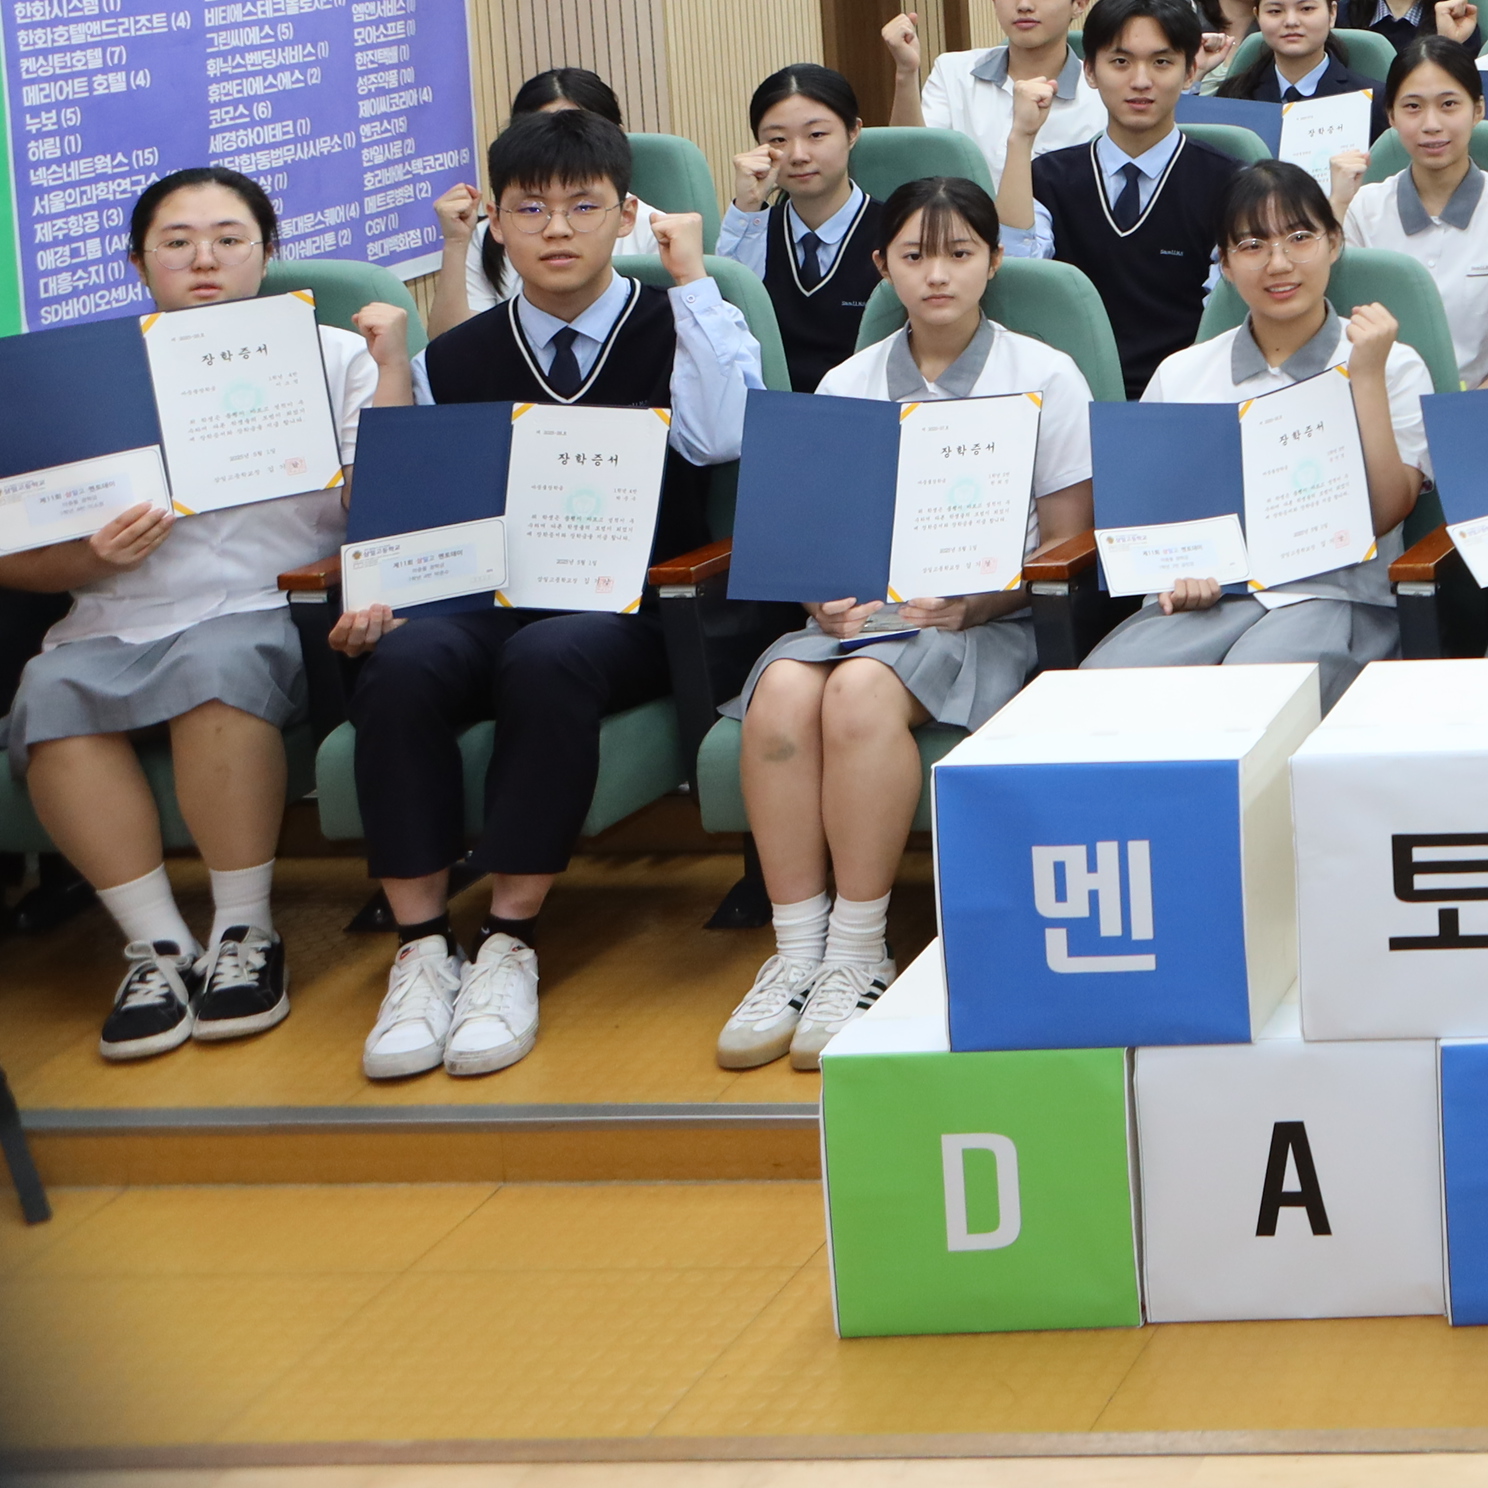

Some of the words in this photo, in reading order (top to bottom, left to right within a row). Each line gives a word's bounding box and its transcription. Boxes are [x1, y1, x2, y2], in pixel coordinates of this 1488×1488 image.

[17, 13, 168, 51] 한화호텔앤드리조트
[171, 11, 191, 31] (4)
[206, 24, 275, 52] 그린씨에스
[277, 22, 293, 42] (5)
[20, 48, 103, 79] 켄싱턴호텔
[107, 46, 126, 66] (7)
[307, 67, 321, 85] (2)
[23, 77, 89, 107] 메리어트
[92, 72, 127, 95] 호텔
[131, 69, 151, 89] (4)
[25, 110, 57, 134] 누보
[61, 106, 81, 128] (5)
[209, 104, 250, 129] 코모스
[253, 101, 272, 120] (6)
[28, 136, 61, 161] 하림
[65, 134, 82, 155] (1)
[208, 121, 294, 154] 세경하이테크
[297, 117, 311, 136] (1)
[132, 147, 159, 168] (15)
[364, 184, 415, 214] 메트로병원
[416, 181, 431, 200] (2)
[34, 211, 99, 244] 제주항공
[103, 207, 123, 228] (3)
[366, 216, 386, 236] CGV
[37, 237, 102, 271] 애경그룹
[367, 228, 422, 261] 현대백화점
[424, 225, 436, 243] (1)
[40, 265, 104, 299] 대흥수지
[108, 261, 125, 282] (1)
[41, 282, 142, 325] SD바이오센서
